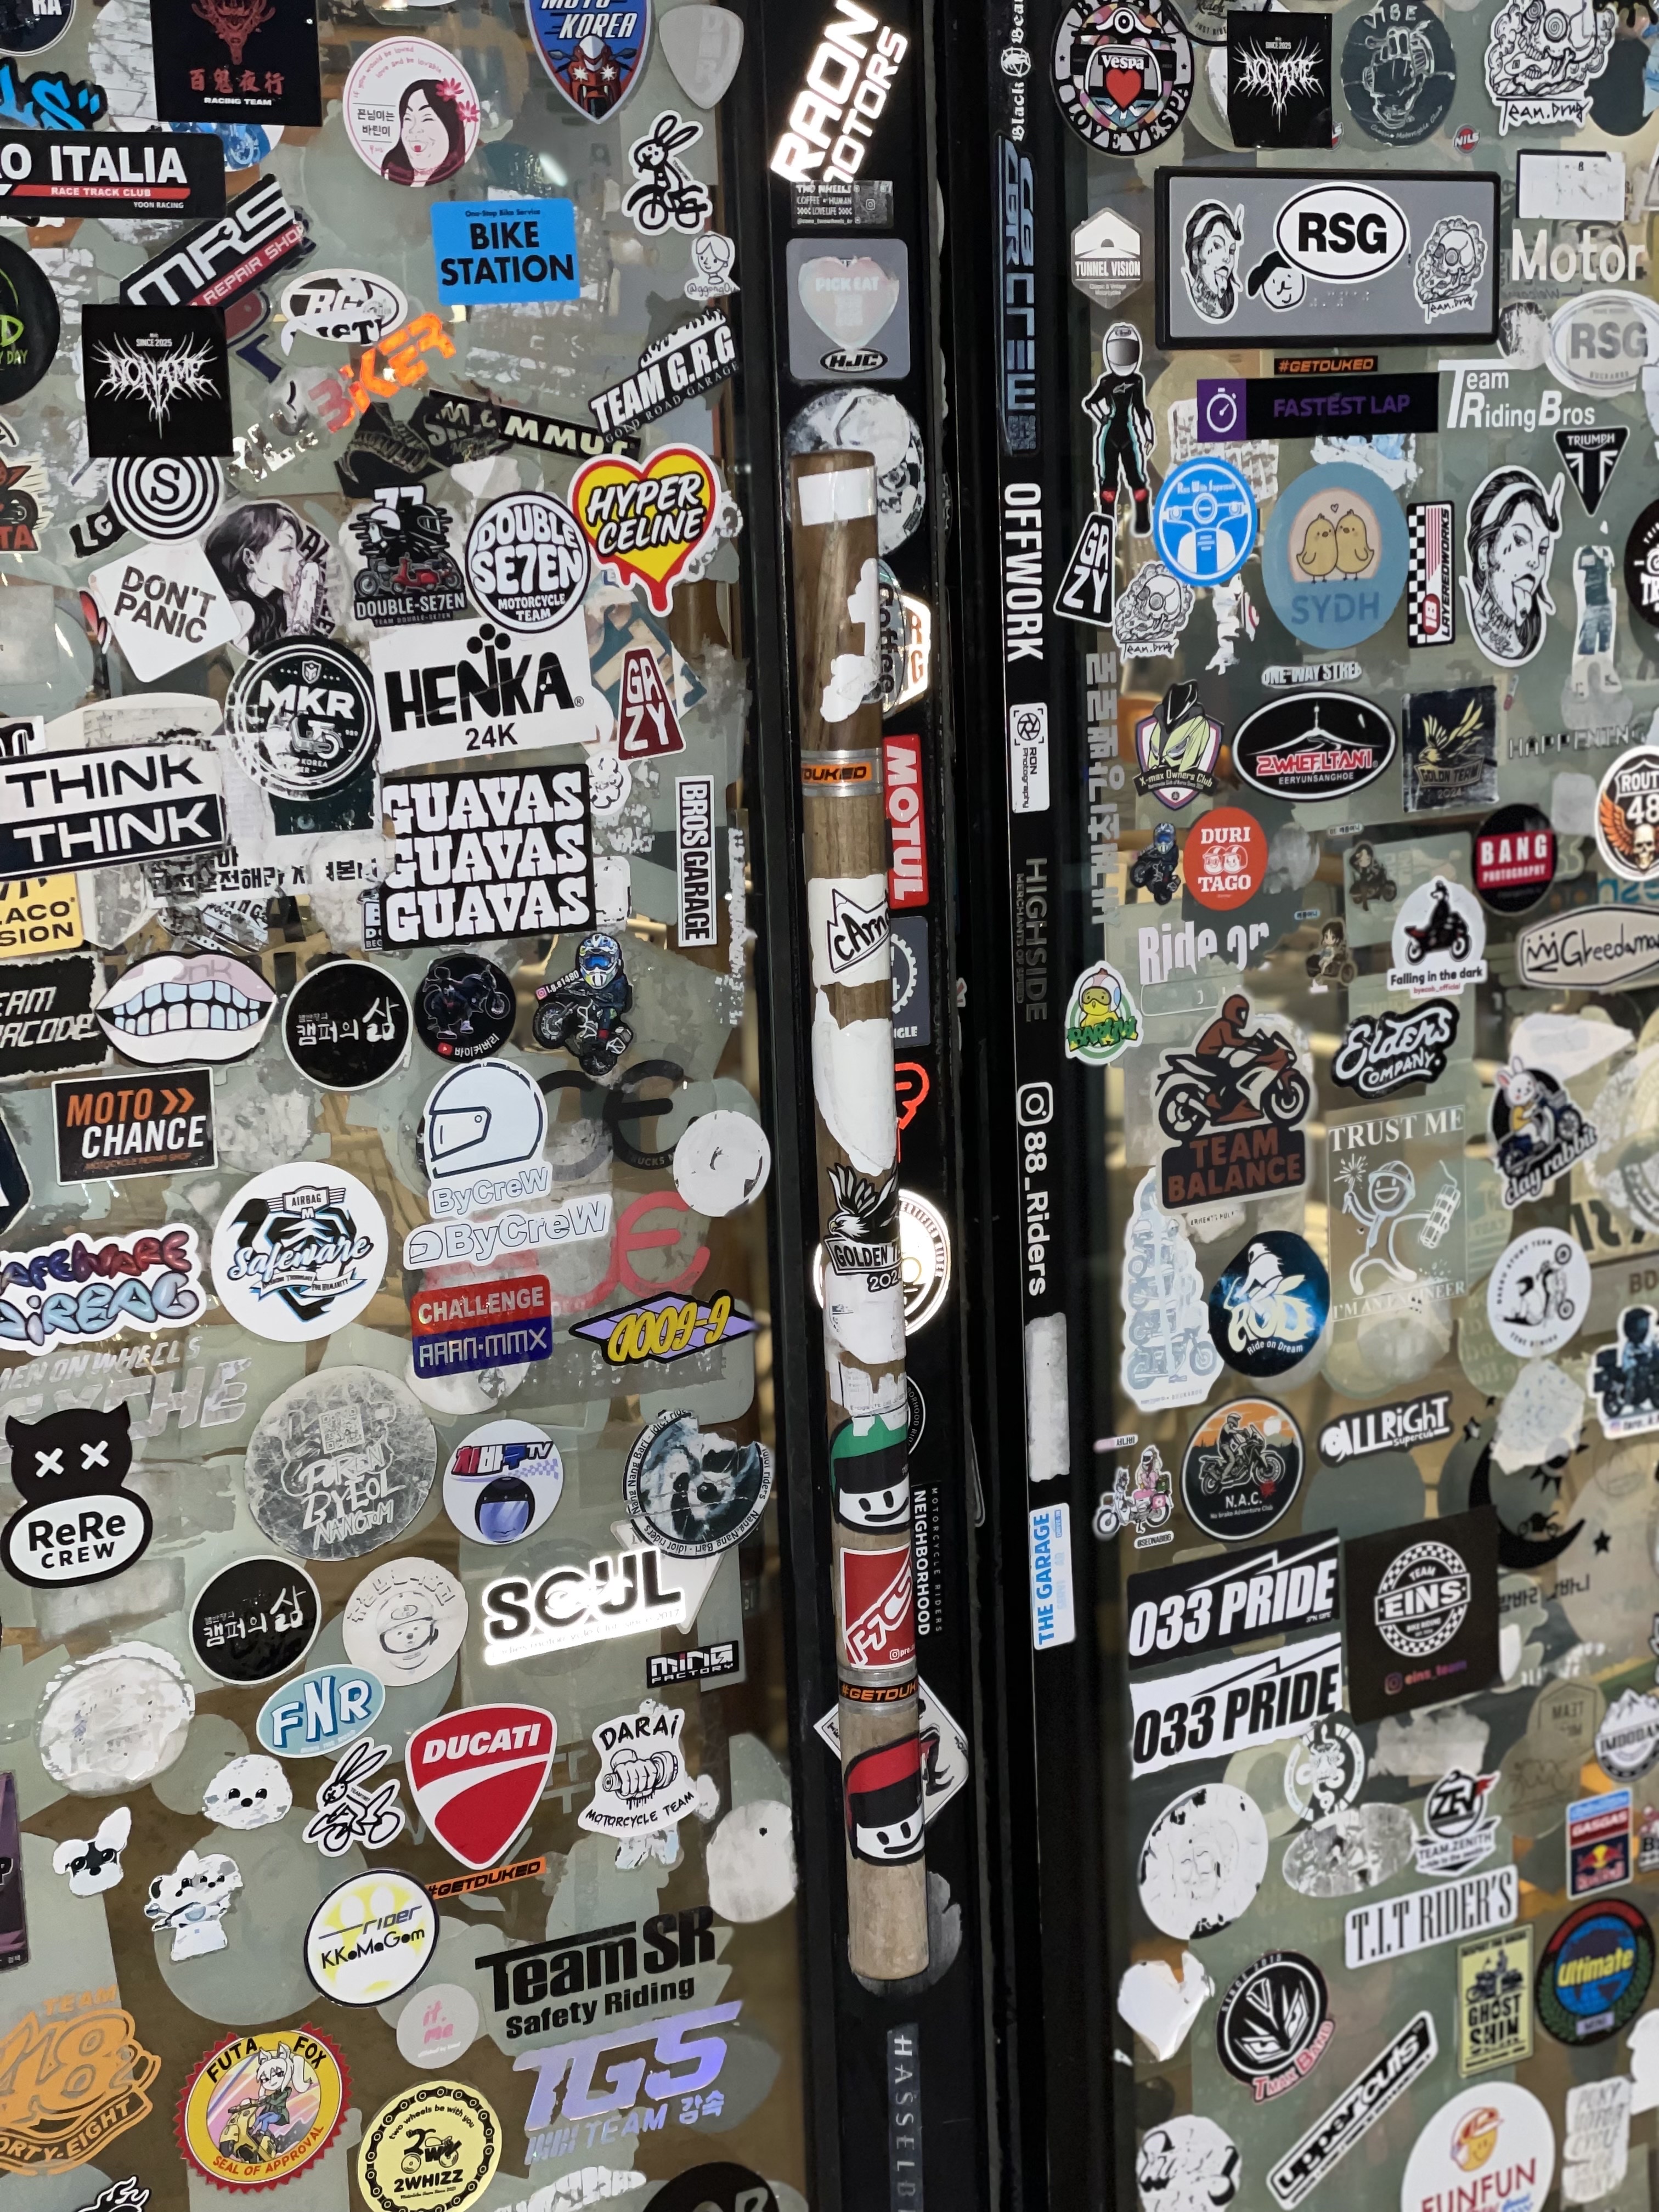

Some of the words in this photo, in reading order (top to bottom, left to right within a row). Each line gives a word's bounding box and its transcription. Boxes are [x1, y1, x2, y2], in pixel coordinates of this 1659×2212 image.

[558, 13, 637, 39] KOREA
[188, 68, 285, 95] 百鬼夜行
[204, 97, 241, 106] RACING
[244, 98, 272, 106] TEAM
[362, 125, 391, 137] 바린이
[1011, 81, 1026, 142] Black
[1453, 132, 1481, 147] NILS
[0, 143, 32, 180] O
[50, 145, 188, 184] ITALIA
[50, 187, 80, 196] RACE
[82, 188, 120, 197] TRACK
[123, 188, 151, 198] CLUB
[499, 208, 514, 217] Bike
[516, 208, 541, 216] Service
[470, 221, 540, 250] BIKE
[1298, 211, 1387, 253] RSG
[203, 257, 263, 304] REPAIR
[264, 224, 305, 261] SHOP
[441, 253, 575, 286] STATION
[1075, 260, 1108, 276] TUNNEL
[1111, 260, 1141, 276] VISION
[1511, 229, 1646, 283] Motor
[7, 350, 28, 365] DAY
[136, 338, 154, 347] SINCE
[154, 338, 172, 347] 2025
[1571, 321, 1649, 359] RSG
[592, 366, 665, 434] TEAM
[668, 325, 736, 390] G.R.G
[828, 353, 882, 368] HJC
[1278, 358, 1374, 375] #GETDUKED
[605, 422, 641, 444] GOLD
[646, 394, 681, 421] ROAD
[686, 362, 740, 397] GARAGE
[1273, 396, 1367, 419] FASTEST
[1372, 394, 1411, 414] LAP
[1567, 433, 1616, 447] TRIUMPH
[150, 466, 180, 504] S
[587, 472, 703, 523] HYPER
[478, 504, 579, 545] DOUBLE
[596, 507, 707, 556] CELINE
[471, 544, 585, 595] SE7EN
[1005, 483, 1044, 663] OFFWORK
[1440, 507, 1451, 638] LAYEREDWORKS
[120, 565, 217, 618] DON'T
[357, 594, 466, 618] DOUBLE-SE7EN
[498, 594, 566, 610] MOTORCYCLE
[1290, 592, 1380, 624] SYDH
[114, 591, 208, 644] PANIC
[516, 609, 551, 622] TEAM
[258, 680, 356, 720] MKR
[465, 723, 518, 752] 24K
[5, 753, 204, 809] THINK
[1022, 747, 1030, 809] Photography
[1029, 747, 1037, 775] RON
[1140, 772, 1165, 787] X-max
[1166, 769, 1196, 781] Owners
[1197, 772, 1214, 787] Club
[382, 771, 585, 836] GUAVAS
[681, 783, 708, 849] BROS
[886, 744, 924, 901] MOTUL
[12, 801, 212, 865] THINK
[1200, 826, 1251, 844] DURI
[1481, 834, 1547, 867] BANG
[385, 823, 588, 890] GUAVAS
[681, 850, 710, 943] GARAGE
[1197, 874, 1251, 893] TAGO
[386, 876, 590, 943] GUAVAS
[1025, 857, 1048, 1023] HIGHSIDE
[1391, 970, 1425, 986] Falling
[1427, 969, 1442, 982] in
[1440, 968, 1457, 981] the
[1460, 966, 1483, 979] dark
[66, 1088, 154, 1128] MOTO
[81, 1114, 207, 1160] CHANCE
[1189, 1127, 1279, 1169] TEAM
[1329, 1115, 1417, 1153] TRUST
[1424, 1106, 1465, 1137] ME
[1167, 1153, 1302, 1203] BALANCE
[291, 1193, 323, 1206] AIRBAG
[1024, 1131, 1051, 1296] 88_Riders
[227, 1234, 375, 1283] Safeware
[833, 1244, 889, 1268] GOLDEN
[417, 1286, 545, 1325] CHALLENGE
[1246, 1340, 1265, 1356] Ride
[1266, 1340, 1276, 1348] on
[1277, 1341, 1304, 1353] Dream
[1225, 1492, 1263, 1509] N.A.C.
[27, 1510, 126, 1552] ReRe
[931, 1487, 940, 1574] MOTORCYCLE
[41, 1541, 115, 1569] CREW
[913, 1489, 930, 1637] NEIGHBORHOOD
[1032, 1514, 1055, 1600] GARAGE
[1409, 1565, 1436, 1582] TEAM
[1129, 1588, 1213, 1657] 033
[1218, 1558, 1338, 1636] PRIDE
[1384, 1581, 1461, 1619] EINS
[1038, 1604, 1055, 1646] THE
[651, 1662, 734, 1684] FACTORY
[271, 1675, 373, 1748] FNR
[1132, 1695, 1216, 1764] 033
[1223, 1663, 1340, 1742] PRIDE
[421, 1723, 541, 1764] DUCATI
[585, 1808, 658, 1829] MOTORCYCLE
[665, 1791, 696, 1816] TEAM
[1572, 1810, 1628, 1837] GASGAS
[428, 1859, 541, 1897] #GETDUKED
[1351, 1898, 1410, 1962] T.I.T
[1419, 1869, 1513, 1944] RIDER'S
[1557, 1949, 1635, 1988] Ultimate
[42, 1984, 119, 2017] TEAM
[505, 1999, 598, 2040] Safety
[604, 1976, 696, 2017] Riding
[1468, 1994, 1523, 2028] GHOST
[205, 2036, 258, 2084] FUTA
[292, 2035, 328, 2070] FOX
[388, 2121, 405, 2141] two
[403, 2106, 433, 2128] wheels
[434, 2103, 445, 2113] be
[447, 2104, 465, 2117] with
[462, 2113, 476, 2129] you
[586, 2103, 668, 2149] TEAM
[679, 2089, 725, 2125] 감속
[212, 2155, 240, 2176] SEAL
[243, 2164, 261, 2177] OF
[264, 2125, 325, 2174] APPROVAL
[393, 2168, 464, 2193] 2WHIZZ
